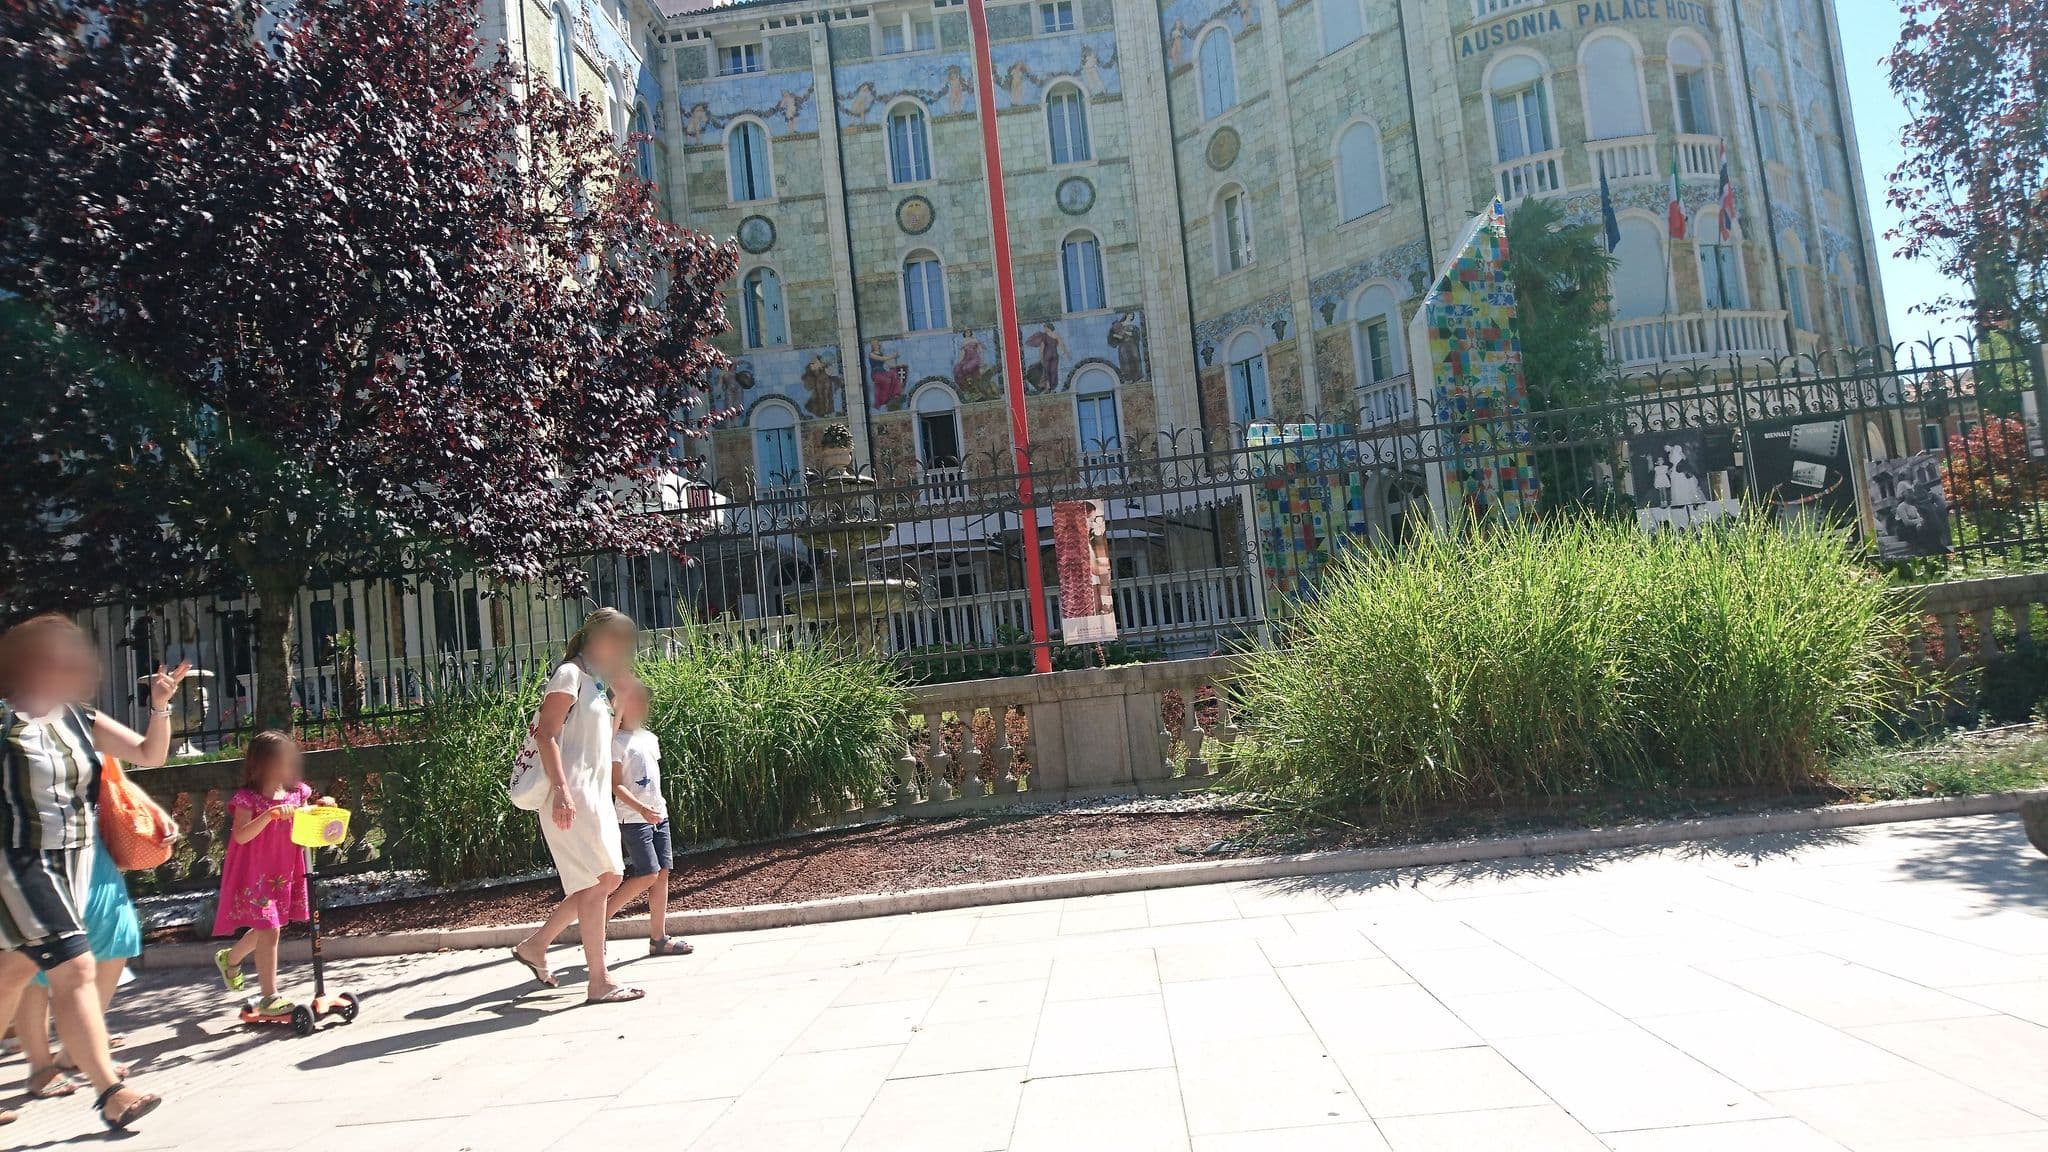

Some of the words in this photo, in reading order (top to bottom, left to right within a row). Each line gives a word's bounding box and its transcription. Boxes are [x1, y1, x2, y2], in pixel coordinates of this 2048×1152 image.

[1461, 9, 1562, 58] AUSONIA
[1577, 0, 1660, 26] PALACE
[1665, 0, 1713, 27] HOTEL
